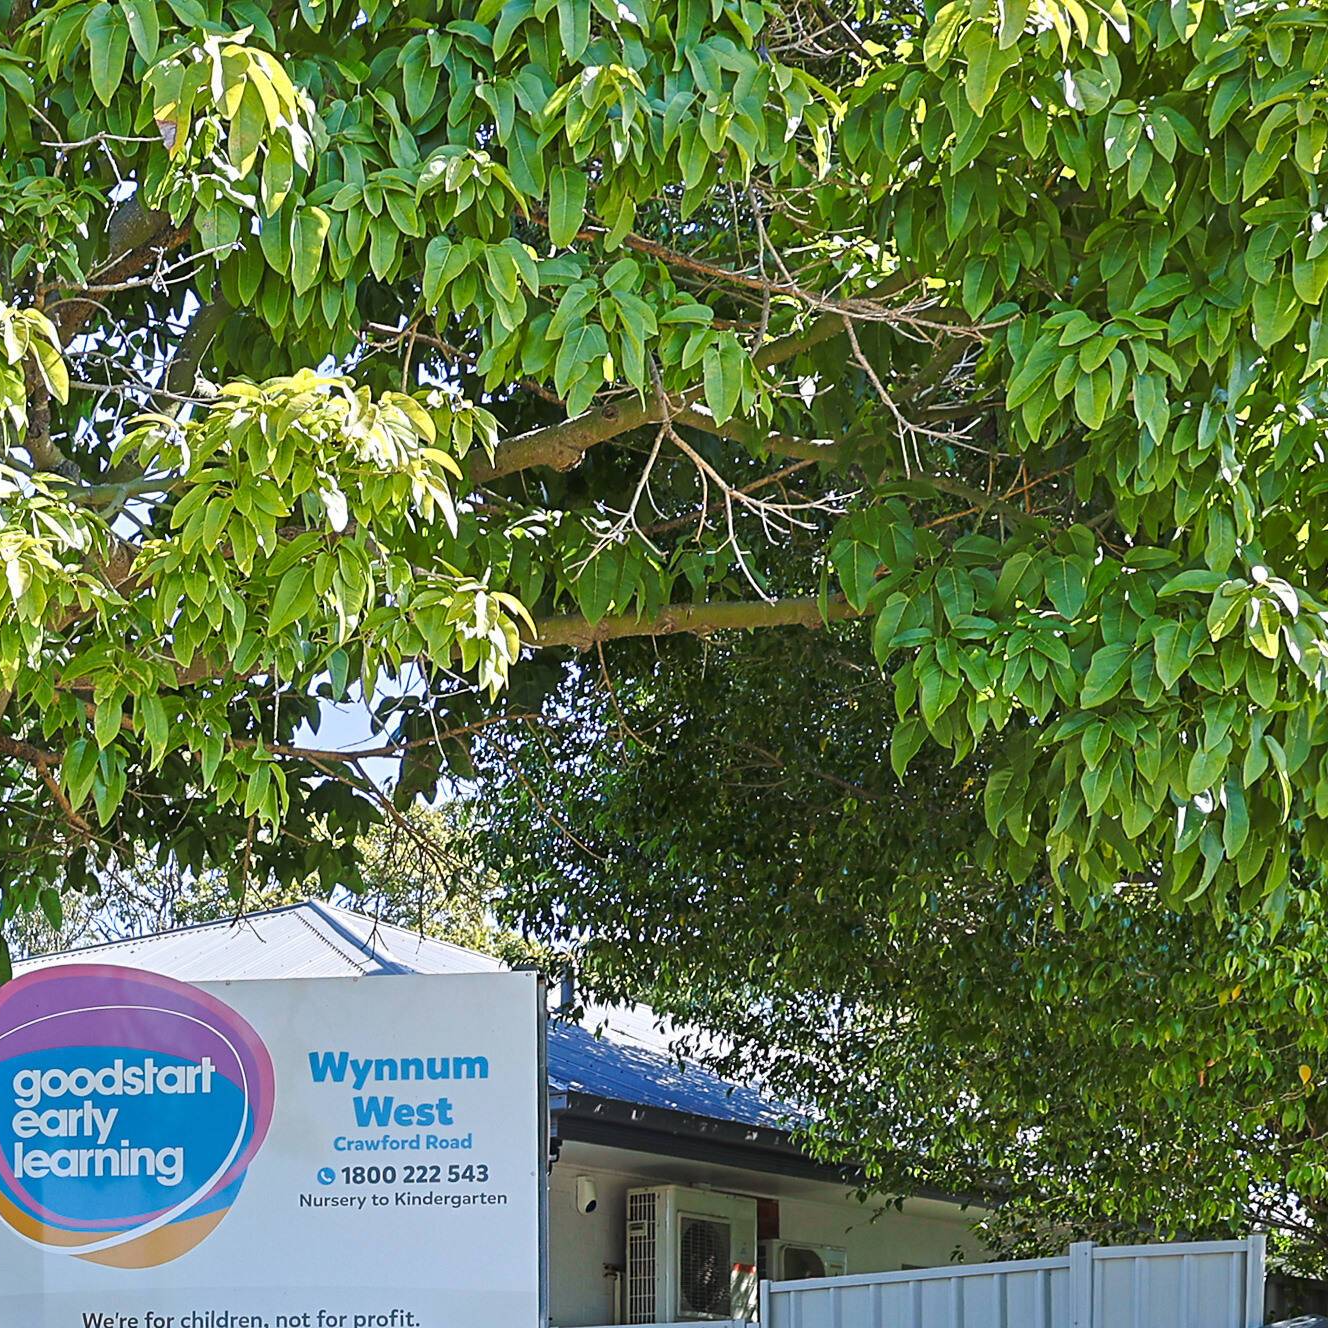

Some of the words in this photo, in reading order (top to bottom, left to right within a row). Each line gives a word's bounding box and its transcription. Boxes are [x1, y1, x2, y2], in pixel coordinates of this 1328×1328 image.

[13, 1057, 216, 1108] goodstart
[308, 1051, 489, 1090] Wynnum
[12, 1100, 119, 1145] early
[353, 1096, 454, 1127] West
[333, 1134, 420, 1151] Crawford
[426, 1133, 472, 1150] Road
[14, 1139, 184, 1186] learning
[341, 1165, 397, 1185] 1800
[403, 1165, 441, 1183] 222
[447, 1164, 489, 1182] 543
[299, 1193, 367, 1209] Nursery
[372, 1194, 389, 1206] to
[395, 1191, 507, 1208] Kindergarten
[144, 1311, 175, 1328] for
[276, 1311, 311, 1328] not
[317, 1309, 347, 1328] for
